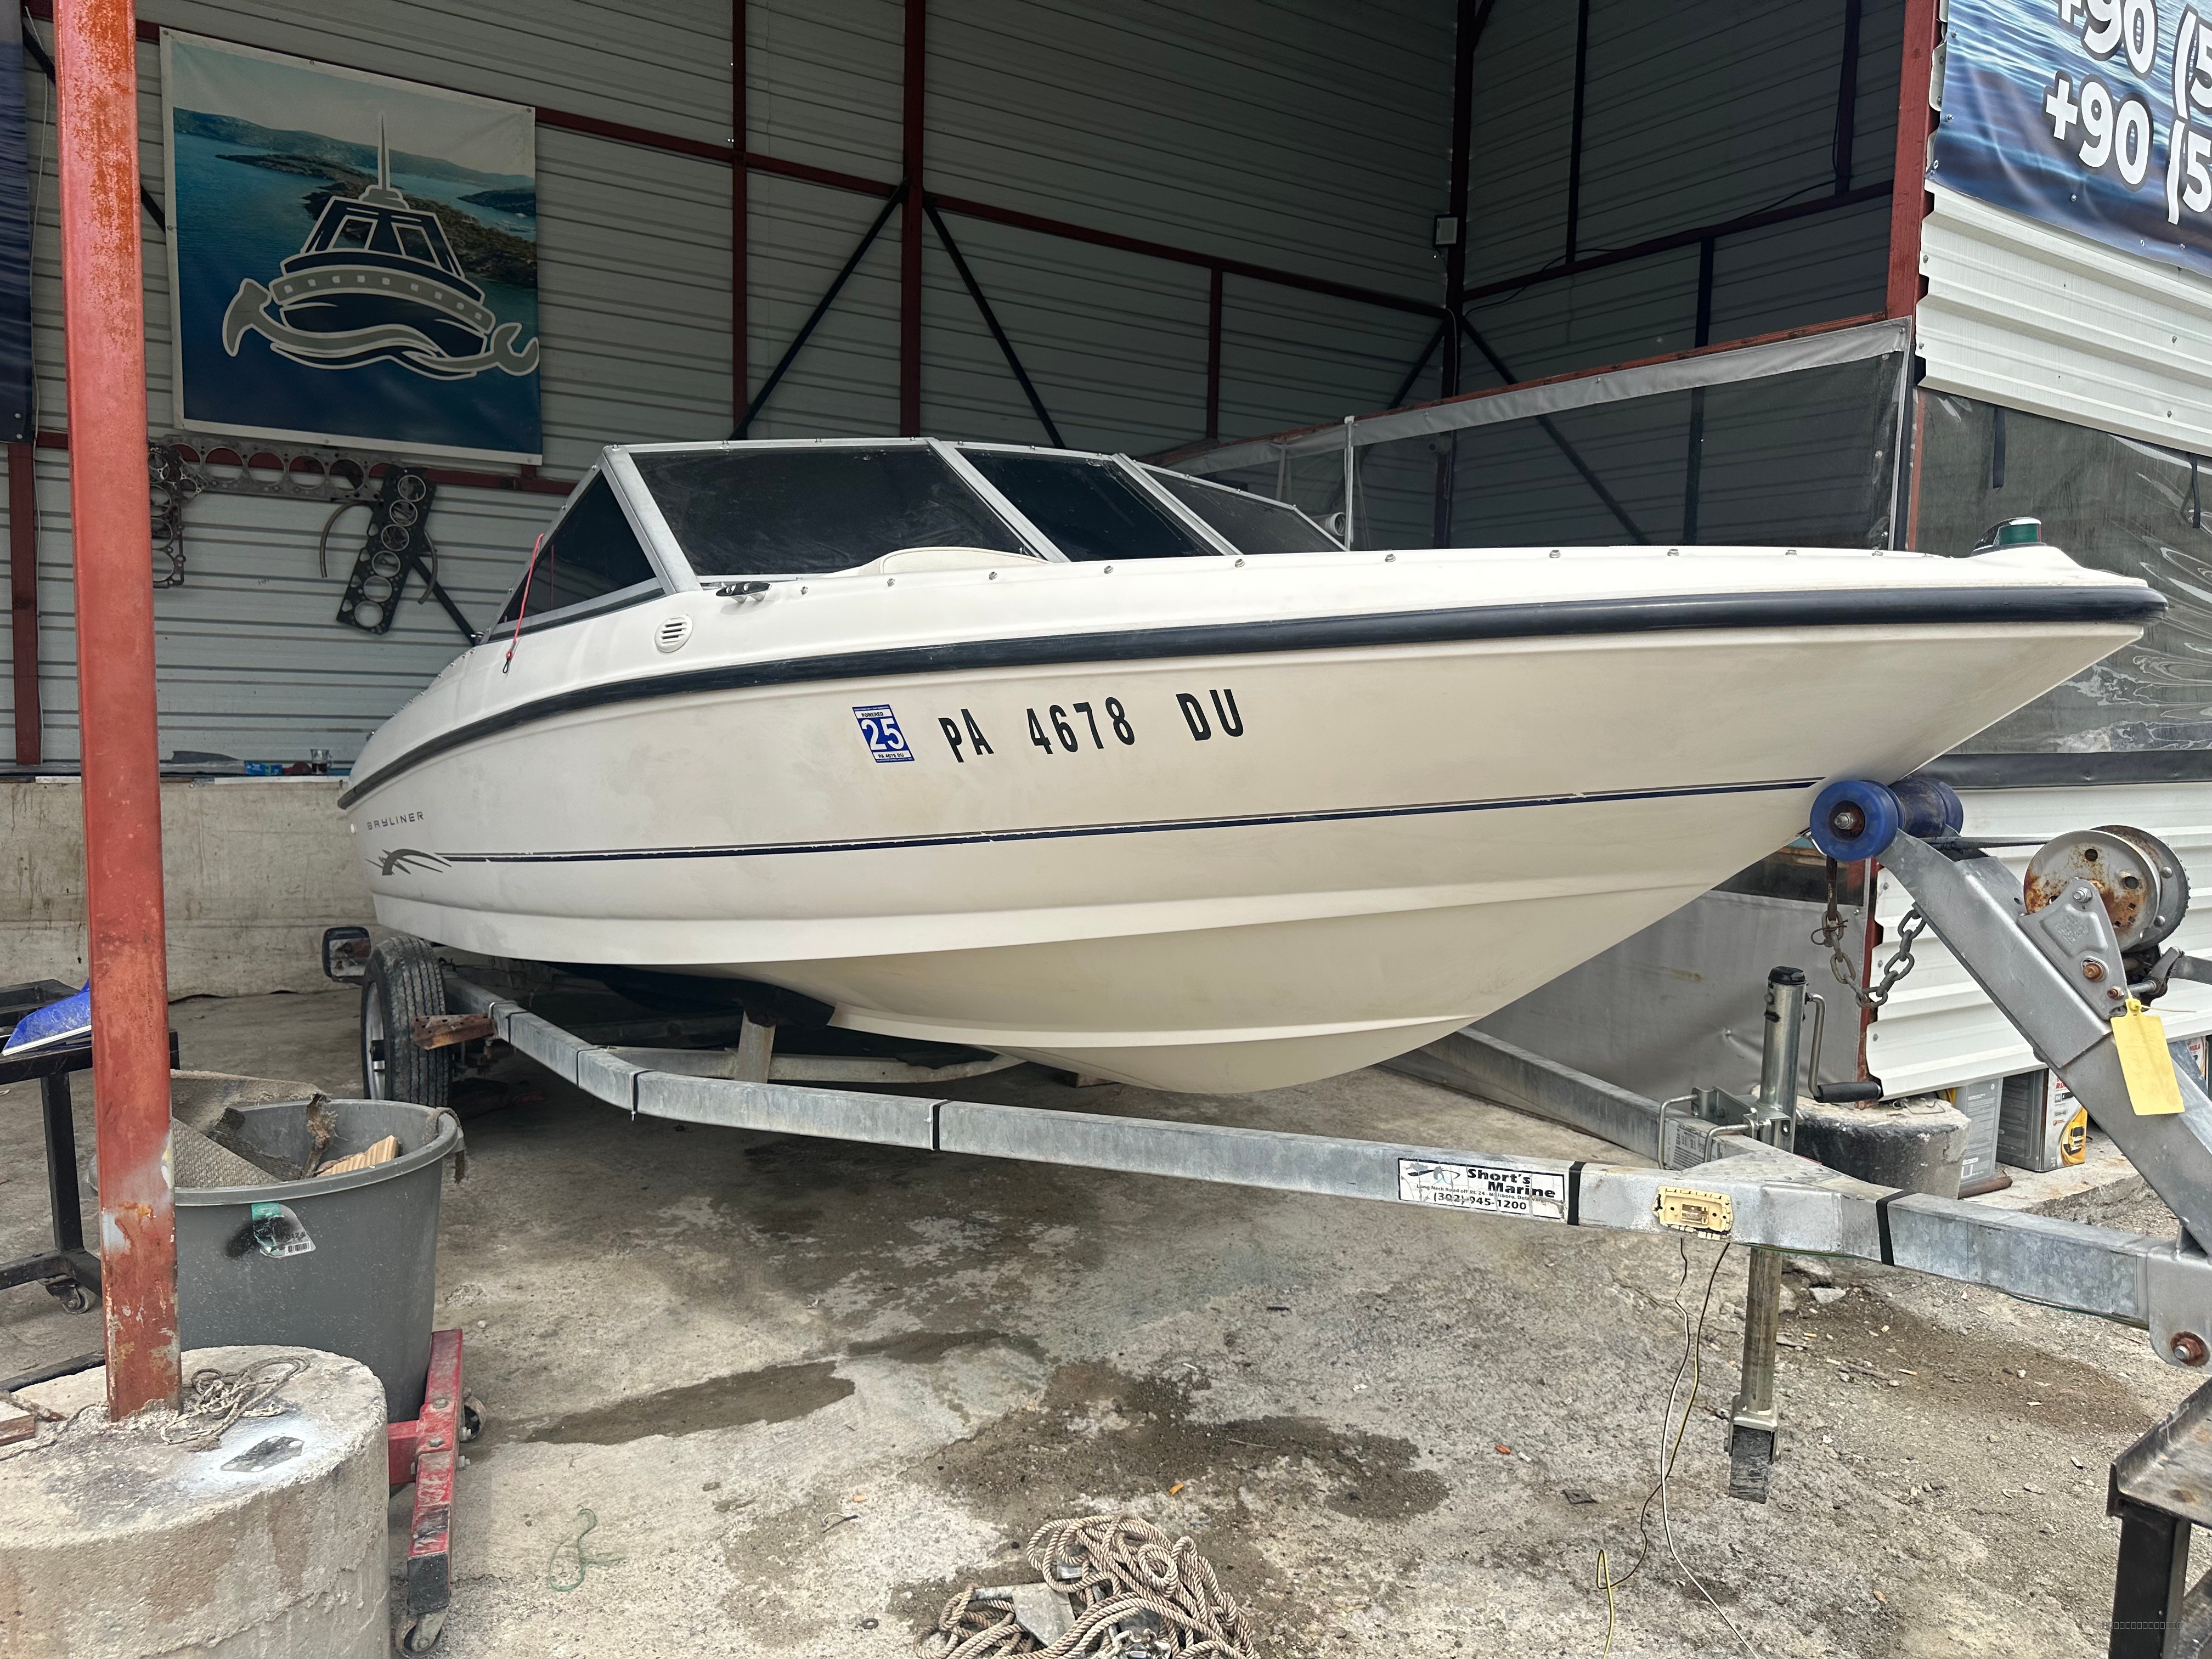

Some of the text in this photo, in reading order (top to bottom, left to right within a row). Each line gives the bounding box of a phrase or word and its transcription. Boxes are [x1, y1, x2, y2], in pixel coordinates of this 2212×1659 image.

[2046, 78, 2151, 185] +90
[861, 718, 904, 750] 25
[939, 689, 1244, 763] PA 4678 DU
[366, 811, 425, 830] BAYLINER
[1467, 1169, 1531, 1184] Short's
[1487, 1181, 1555, 1198] Marine
[1434, 1192, 1527, 1210] (302) 945-1200
